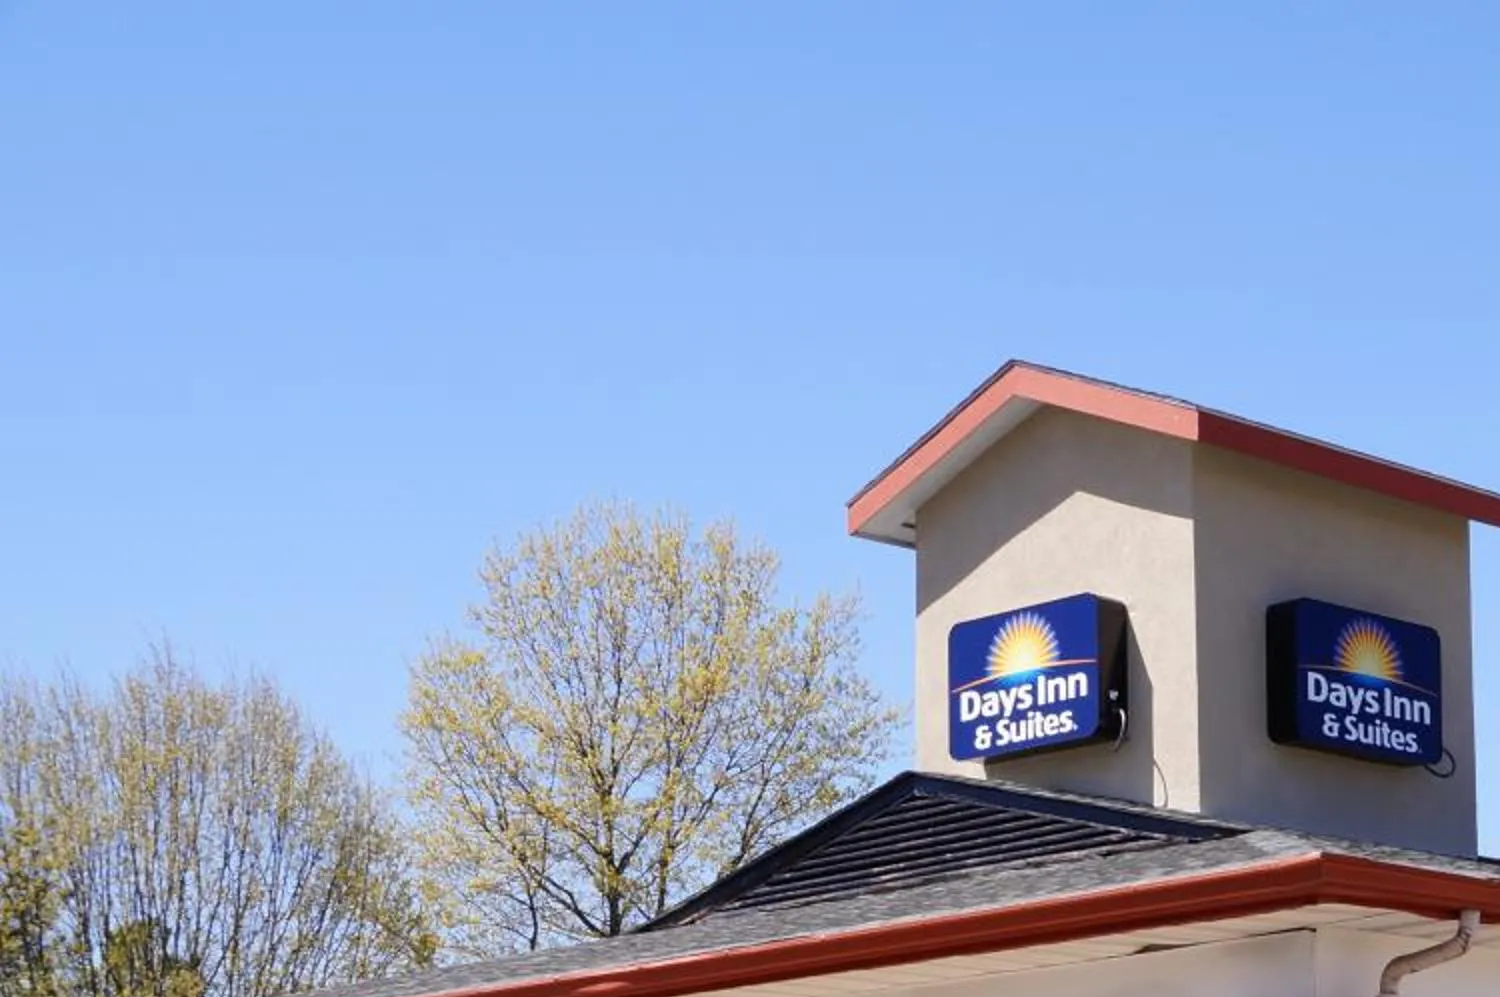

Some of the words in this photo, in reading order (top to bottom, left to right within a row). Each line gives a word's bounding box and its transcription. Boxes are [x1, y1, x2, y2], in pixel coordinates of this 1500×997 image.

[960, 683, 1033, 722] Days
[1037, 672, 1088, 706] Inn
[1307, 671, 1380, 715] Days
[1384, 687, 1431, 725] Inn
[974, 724, 992, 750] &
[995, 710, 1073, 747] Suites
[1322, 713, 1340, 738] &
[1344, 715, 1419, 753] Suites
